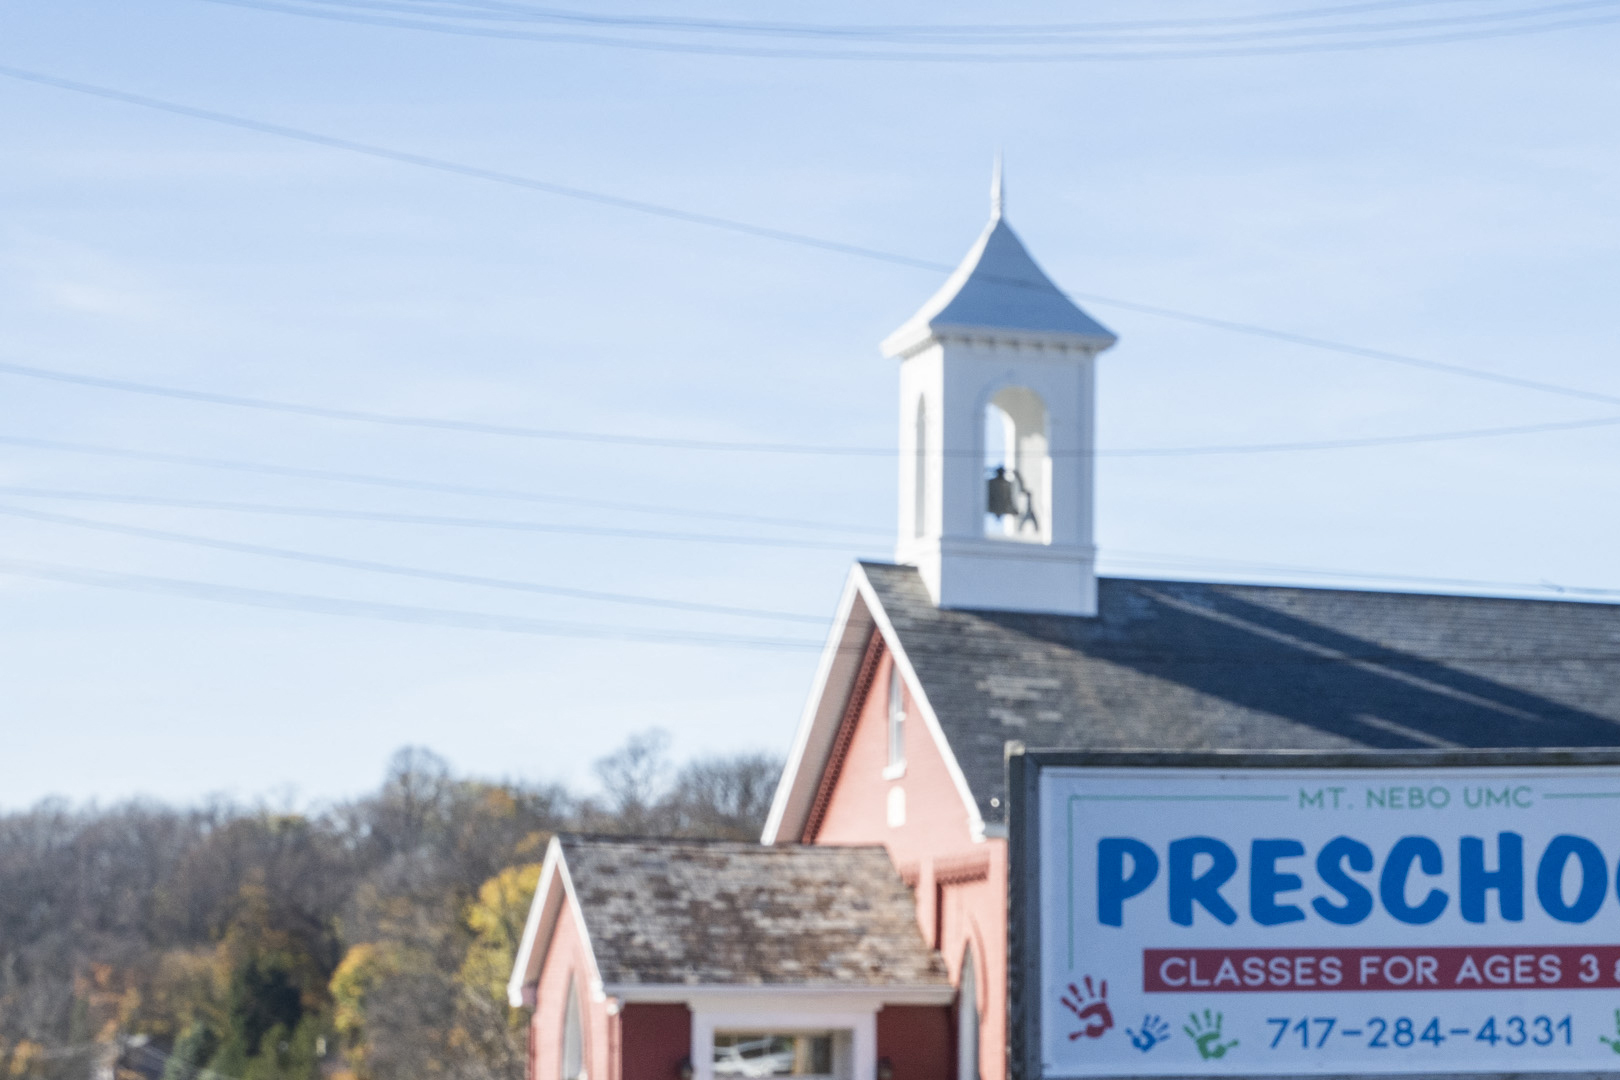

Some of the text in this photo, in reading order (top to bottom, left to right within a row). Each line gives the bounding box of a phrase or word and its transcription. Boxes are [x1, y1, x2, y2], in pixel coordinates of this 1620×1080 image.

[1298, 785, 1534, 810] MT. NEBO UMC
[1159, 956, 1343, 987] CLASSES
[1359, 955, 1439, 986] FOR
[1455, 953, 1562, 985] AGES
[1578, 953, 1600, 984] 3
[1266, 1014, 1573, 1049] 717-284-4331
